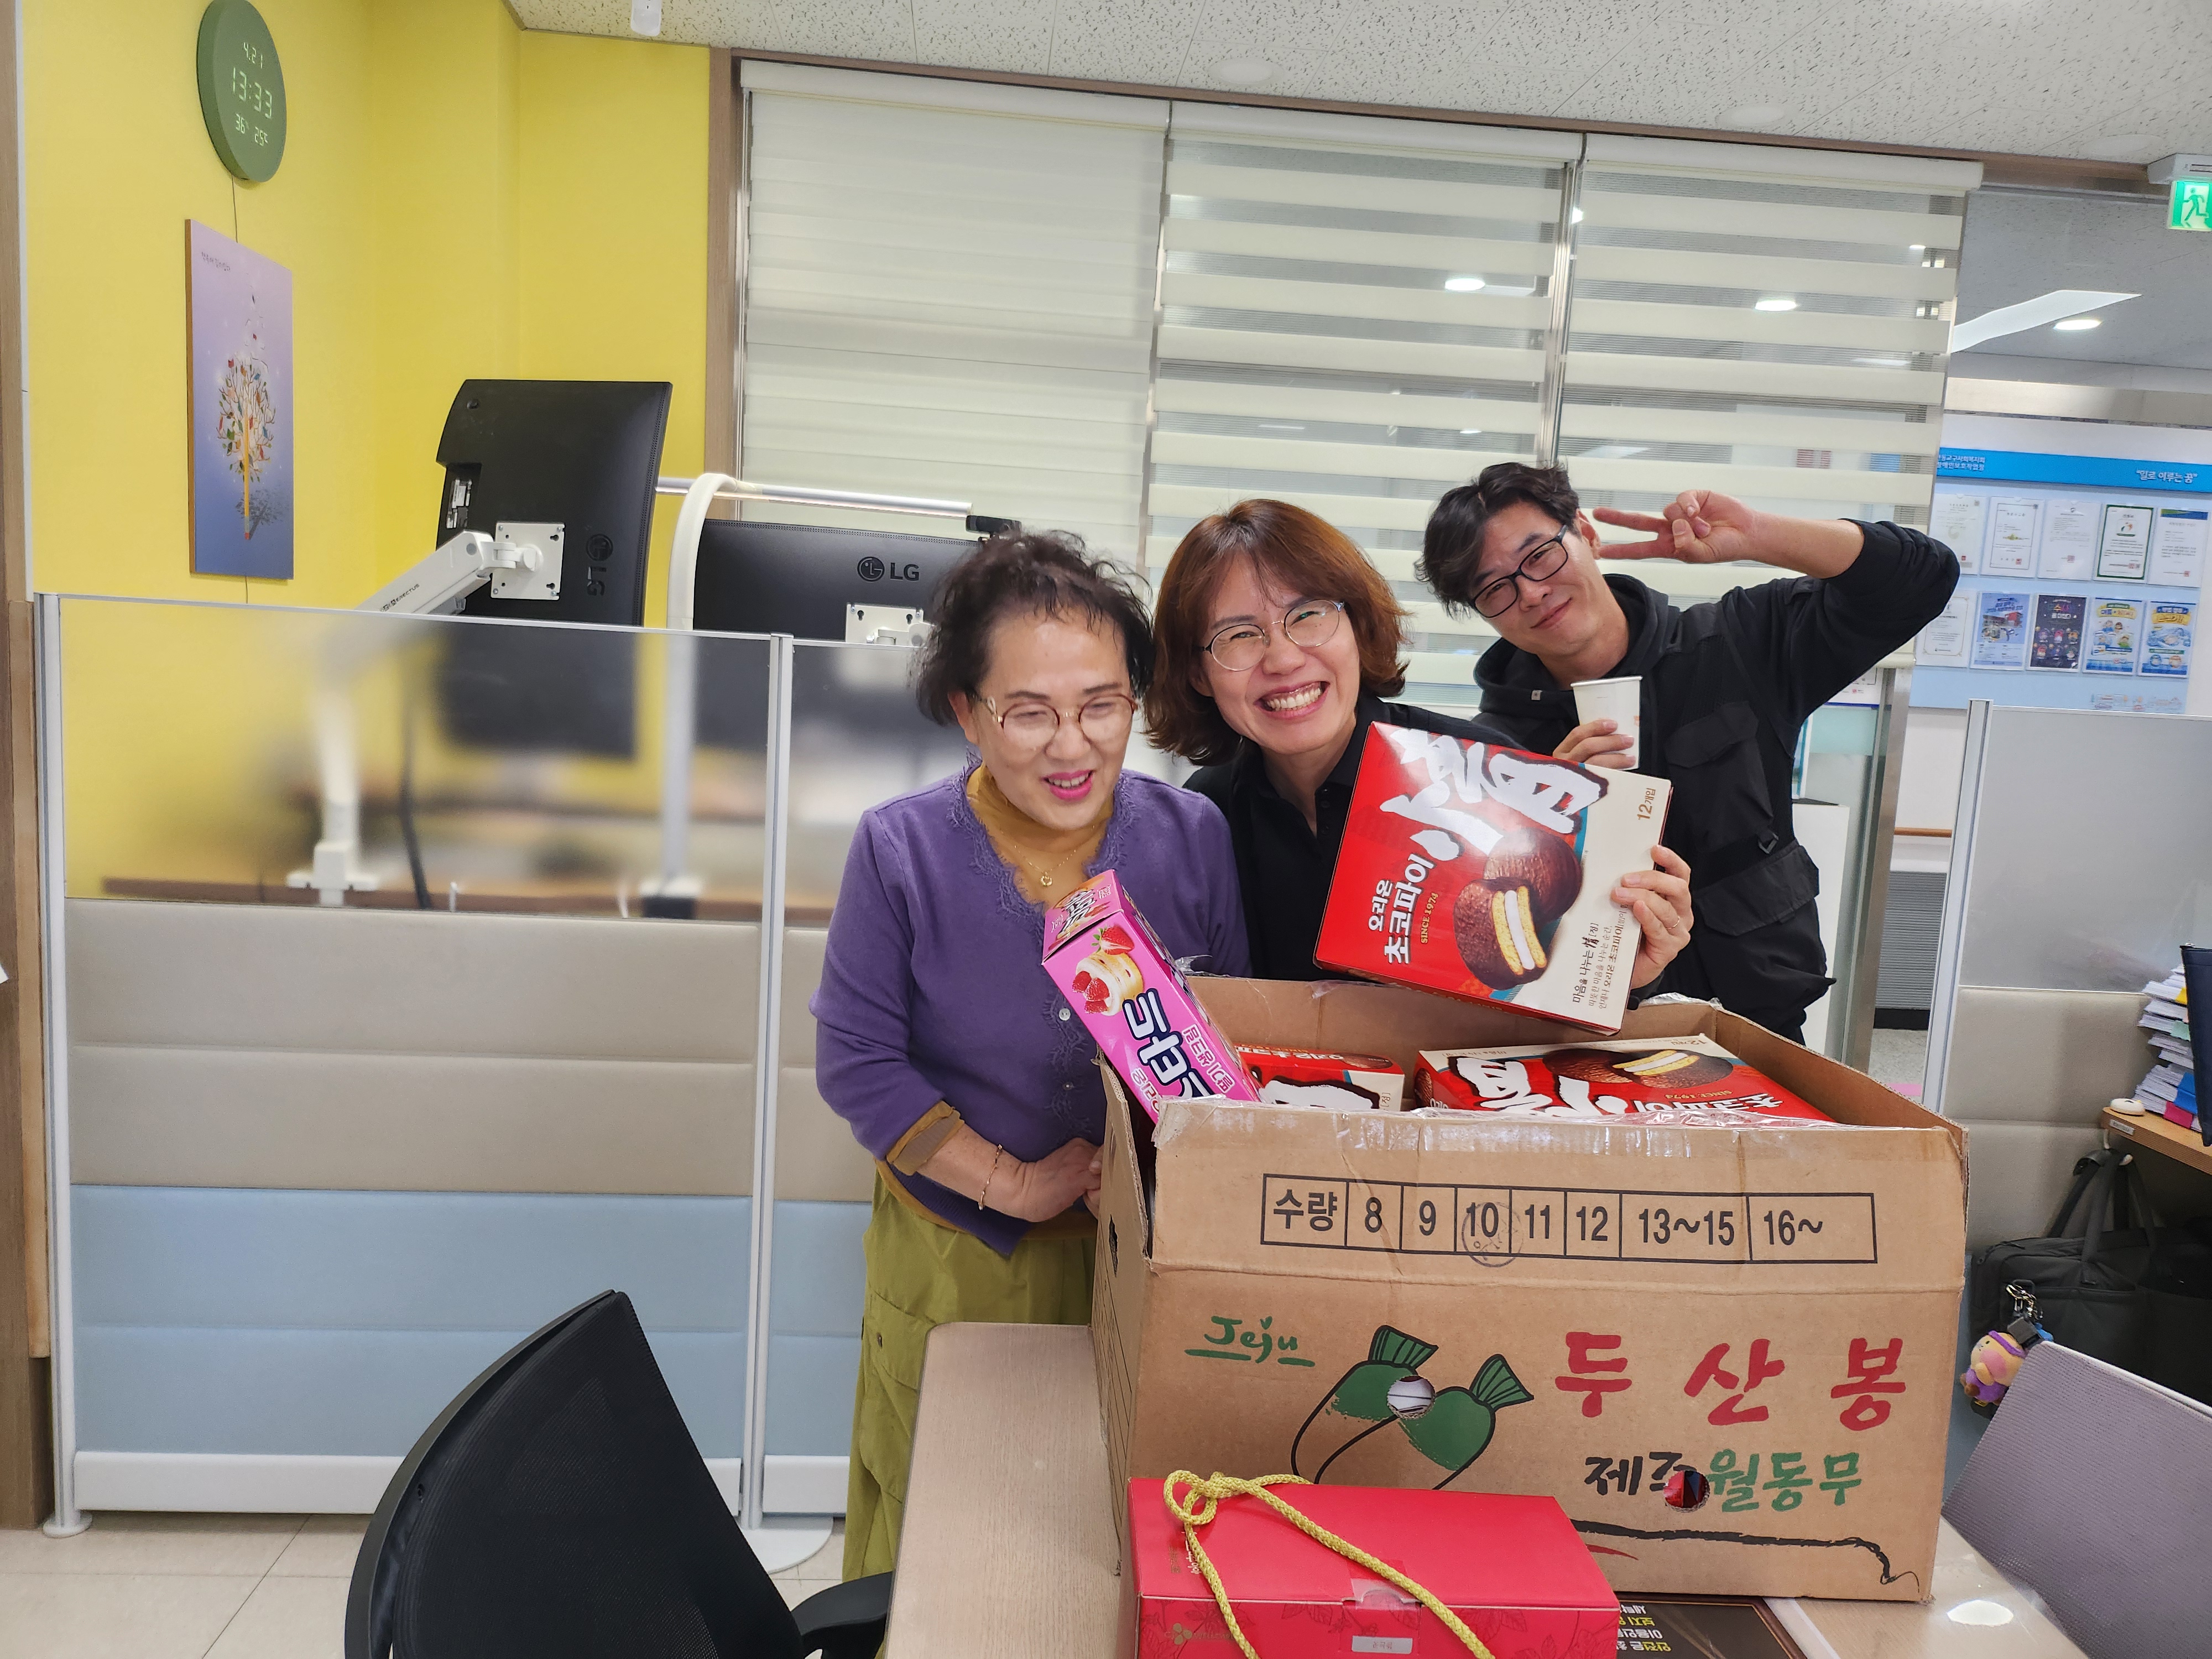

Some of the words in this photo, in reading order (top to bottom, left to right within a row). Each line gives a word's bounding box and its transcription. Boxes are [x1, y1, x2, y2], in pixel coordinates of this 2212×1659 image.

[232, 66, 272, 119] 13:33
[1938, 455, 1985, 463] 동교구사회복지회
[587, 566, 607, 596] LG
[890, 562, 920, 581] LG
[1637, 788, 1656, 820] 12개입
[1368, 879, 1393, 932] 오리온
[1384, 853, 1436, 964] 초코파이
[1423, 891, 1439, 915] 1974
[1421, 916, 1430, 944] SINCE
[1579, 950, 1594, 975] 나누는
[1598, 942, 1609, 962] 나누는
[1593, 964, 1604, 984] 마음을
[1604, 964, 1615, 988] 오리온
[1573, 978, 1588, 1003] 마음을
[1588, 986, 1600, 1006] 따뜻한
[1183, 1025, 1215, 1067] 생크림
[1207, 1063, 1235, 1093] 딸기
[1697, 1090, 1733, 1098] SINCE
[1272, 1189, 1338, 1232] 수량
[1364, 1197, 1383, 1233] 8
[1418, 1200, 1437, 1236] 9
[1466, 1202, 1499, 1238] 10
[1525, 1204, 1550, 1239] 11
[1576, 1206, 1608, 1241] 12
[1639, 1208, 1735, 1246] 13~15
[1764, 1210, 1823, 1246] 16~
[1204, 1316, 1298, 1363] Jeju
[1620, 1604, 1646, 1614] 세탁
